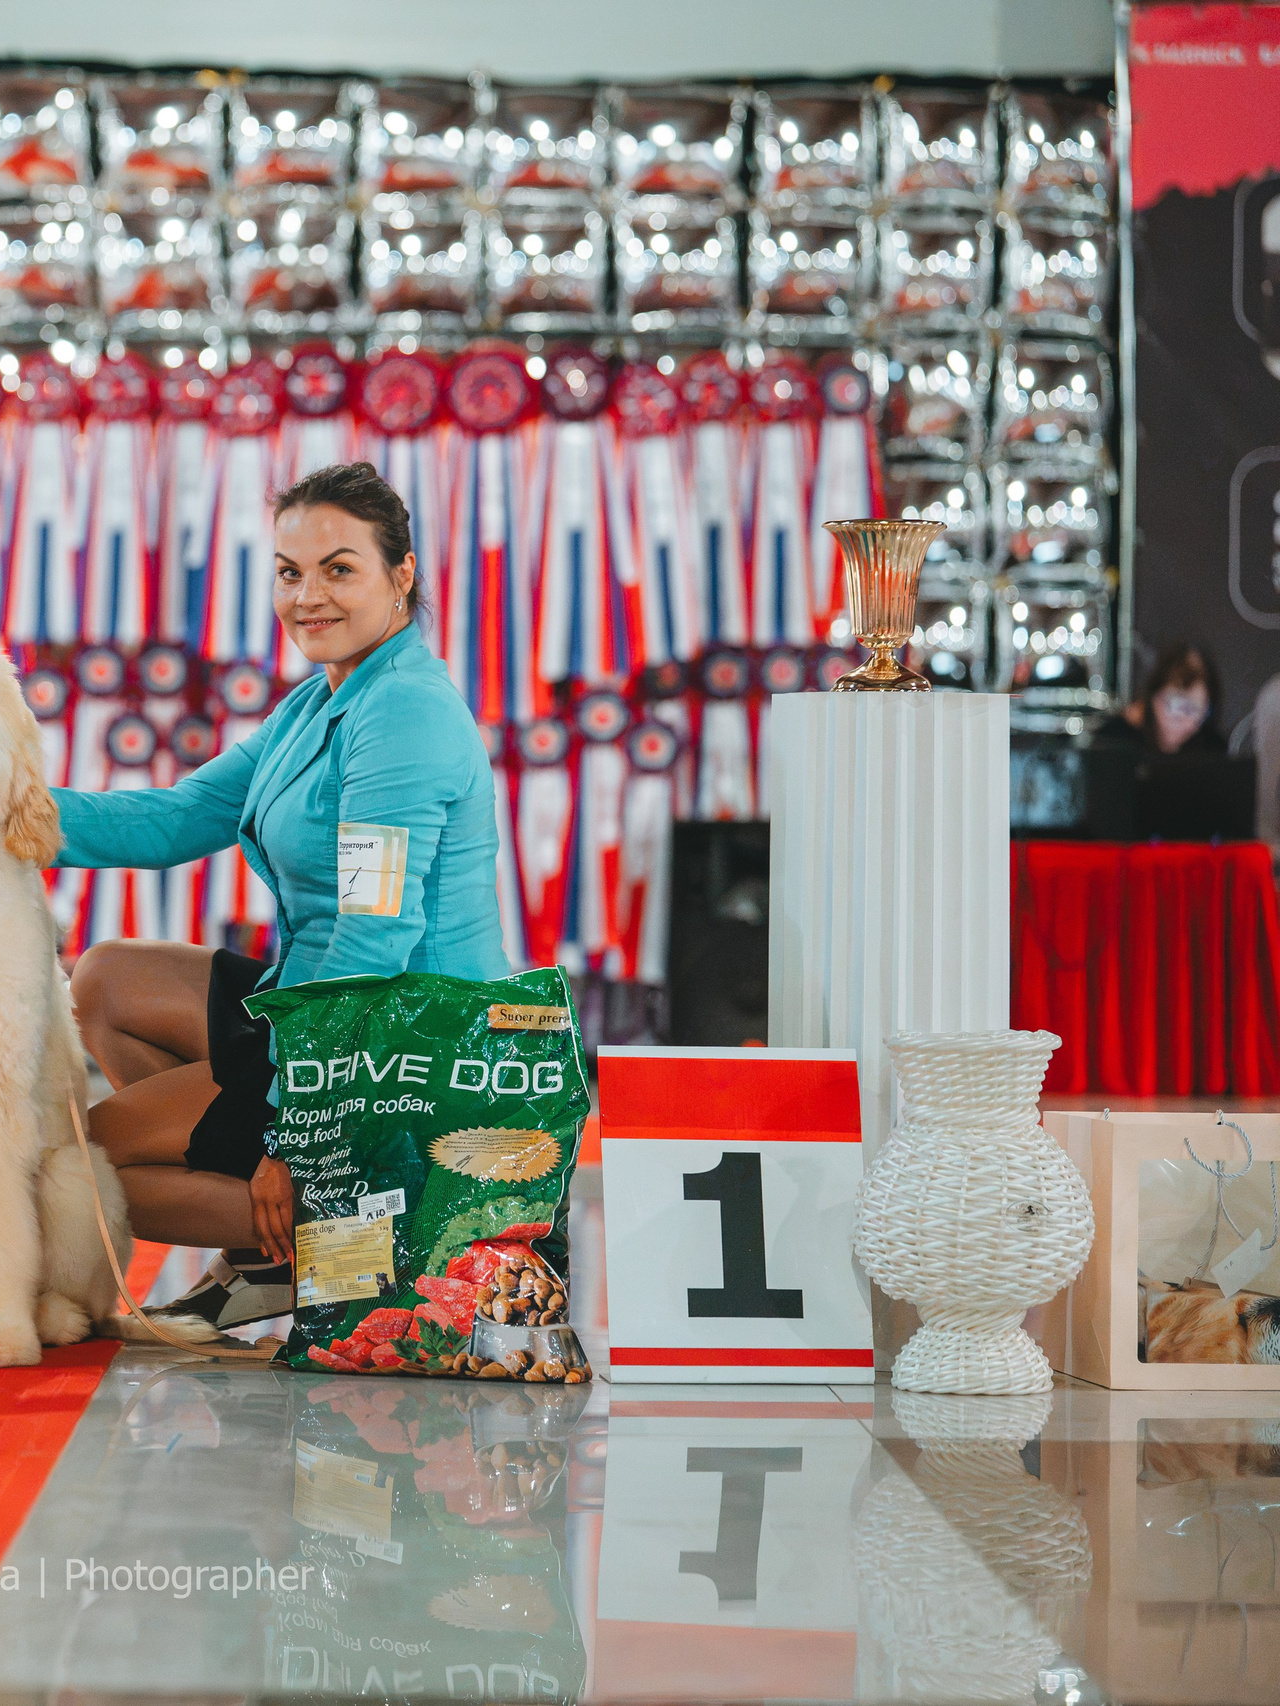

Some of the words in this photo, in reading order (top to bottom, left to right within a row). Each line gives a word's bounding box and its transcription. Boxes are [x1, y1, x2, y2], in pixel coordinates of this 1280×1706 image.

[499, 1008, 534, 1025] Super
[286, 1051, 433, 1093] DRIVE
[449, 1058, 564, 1095] DOG
[281, 1106, 332, 1128] Корм
[334, 1098, 366, 1122] для
[373, 1093, 436, 1115] собак
[278, 1129, 310, 1148] dog
[314, 1121, 342, 1143] food
[317, 1145, 353, 1169] appetit
[319, 1223, 336, 1236] dogs
[682, 1151, 804, 1319] 1
